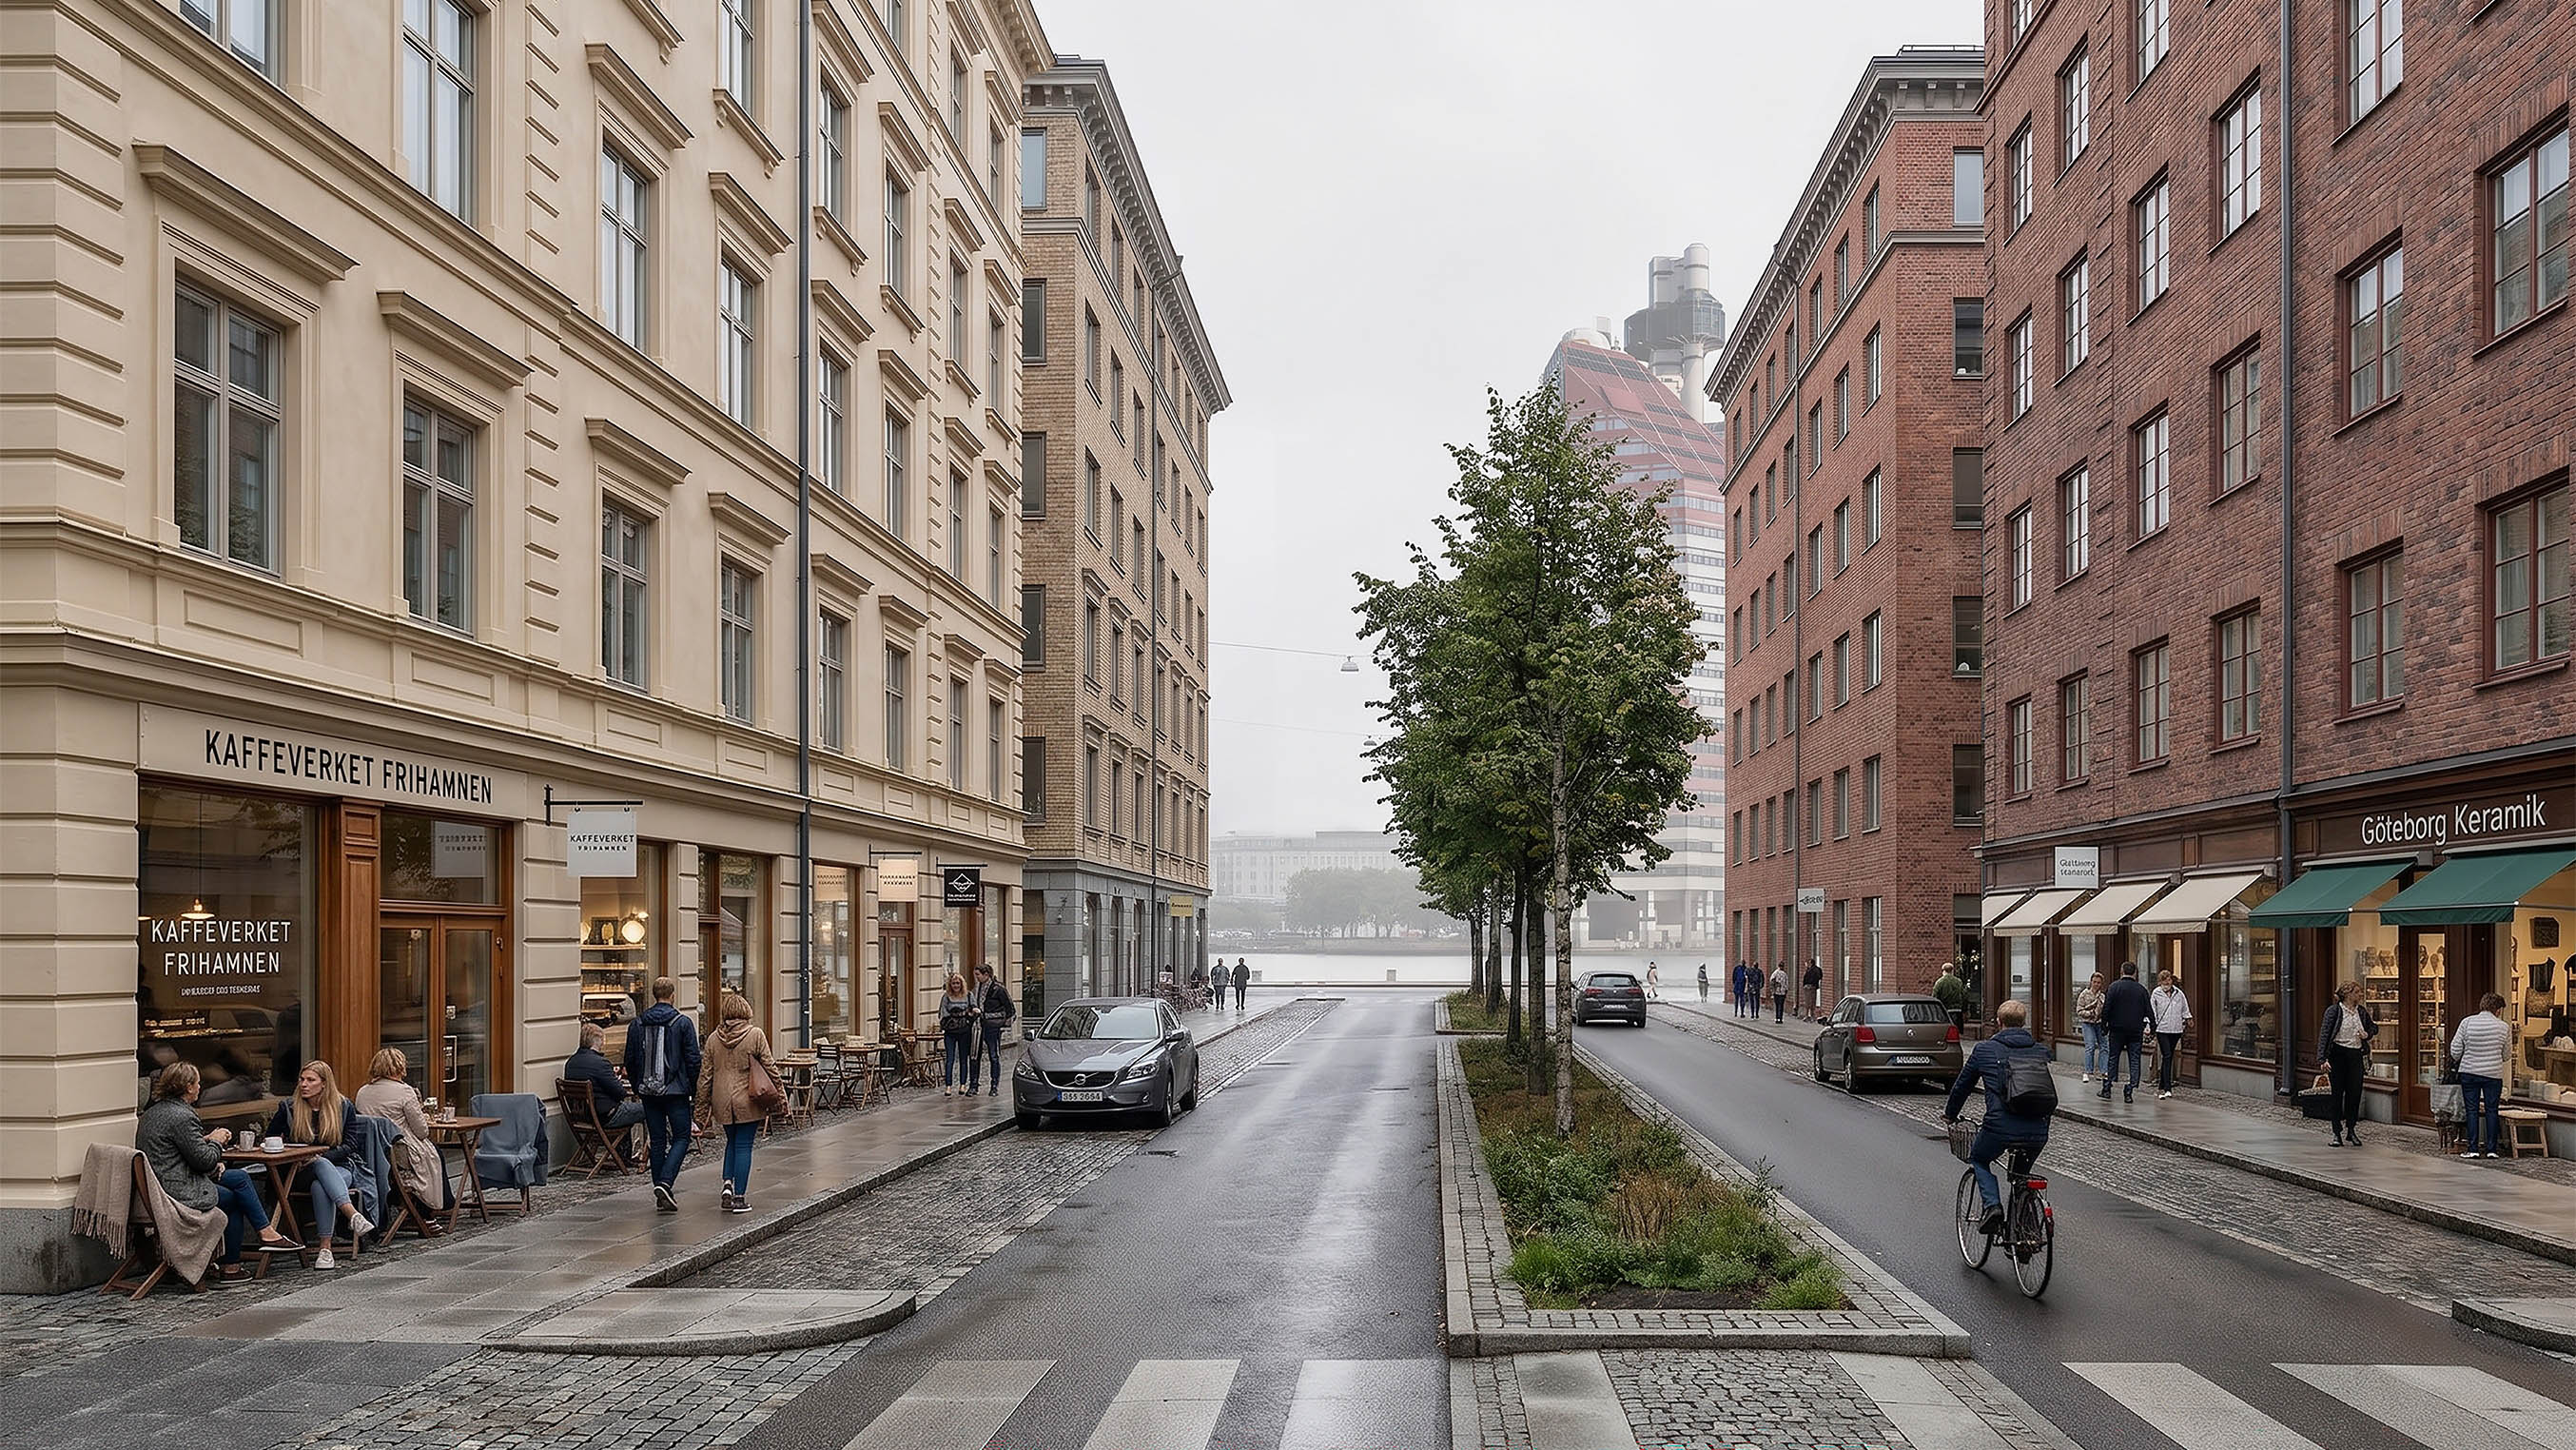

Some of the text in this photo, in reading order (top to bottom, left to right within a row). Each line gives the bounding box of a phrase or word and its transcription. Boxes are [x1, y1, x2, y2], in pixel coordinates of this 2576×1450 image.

[205, 729, 492, 804] KAFFEVERKET FRIHAMNEN
[2361, 794, 2547, 846] Göteborg Keramik
[570, 834, 634, 843] KAFFEVERKET
[151, 919, 291, 943] KAFFEVERKET
[165, 951, 280, 976] FRIHAMNEN
